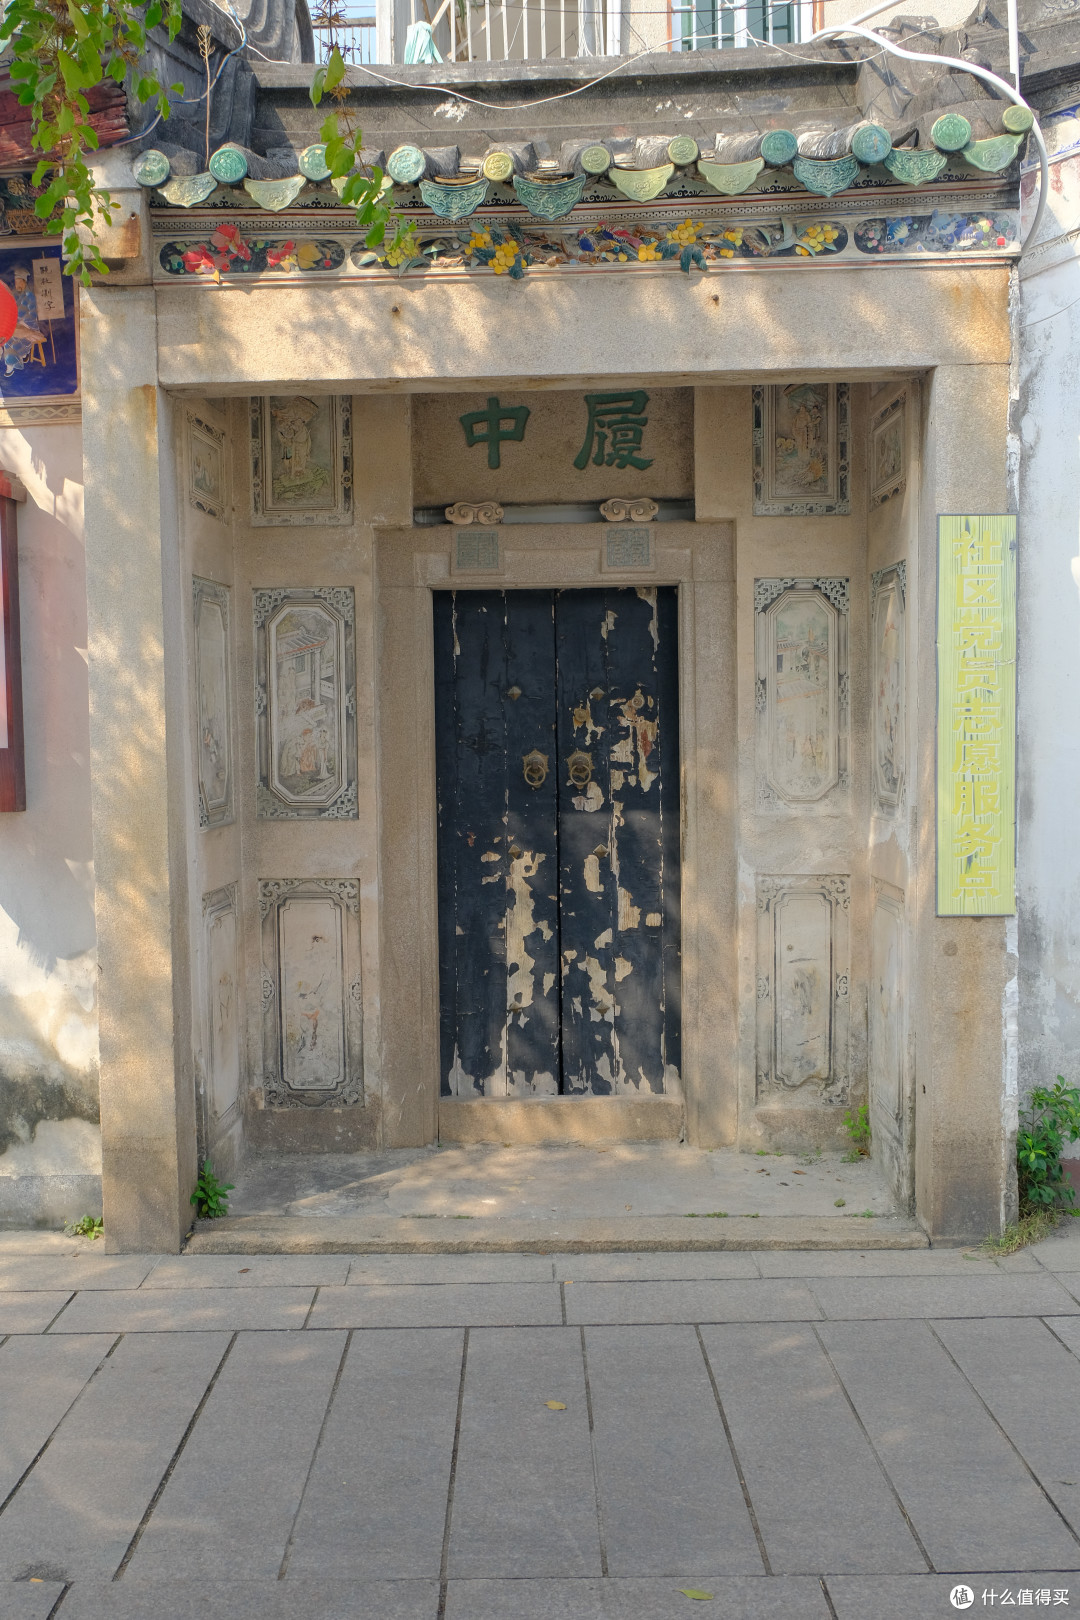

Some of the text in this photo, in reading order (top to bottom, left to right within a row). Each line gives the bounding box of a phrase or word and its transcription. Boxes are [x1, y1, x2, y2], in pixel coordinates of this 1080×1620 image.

[952, 529, 1004, 898] 社区党员志愿服务点
